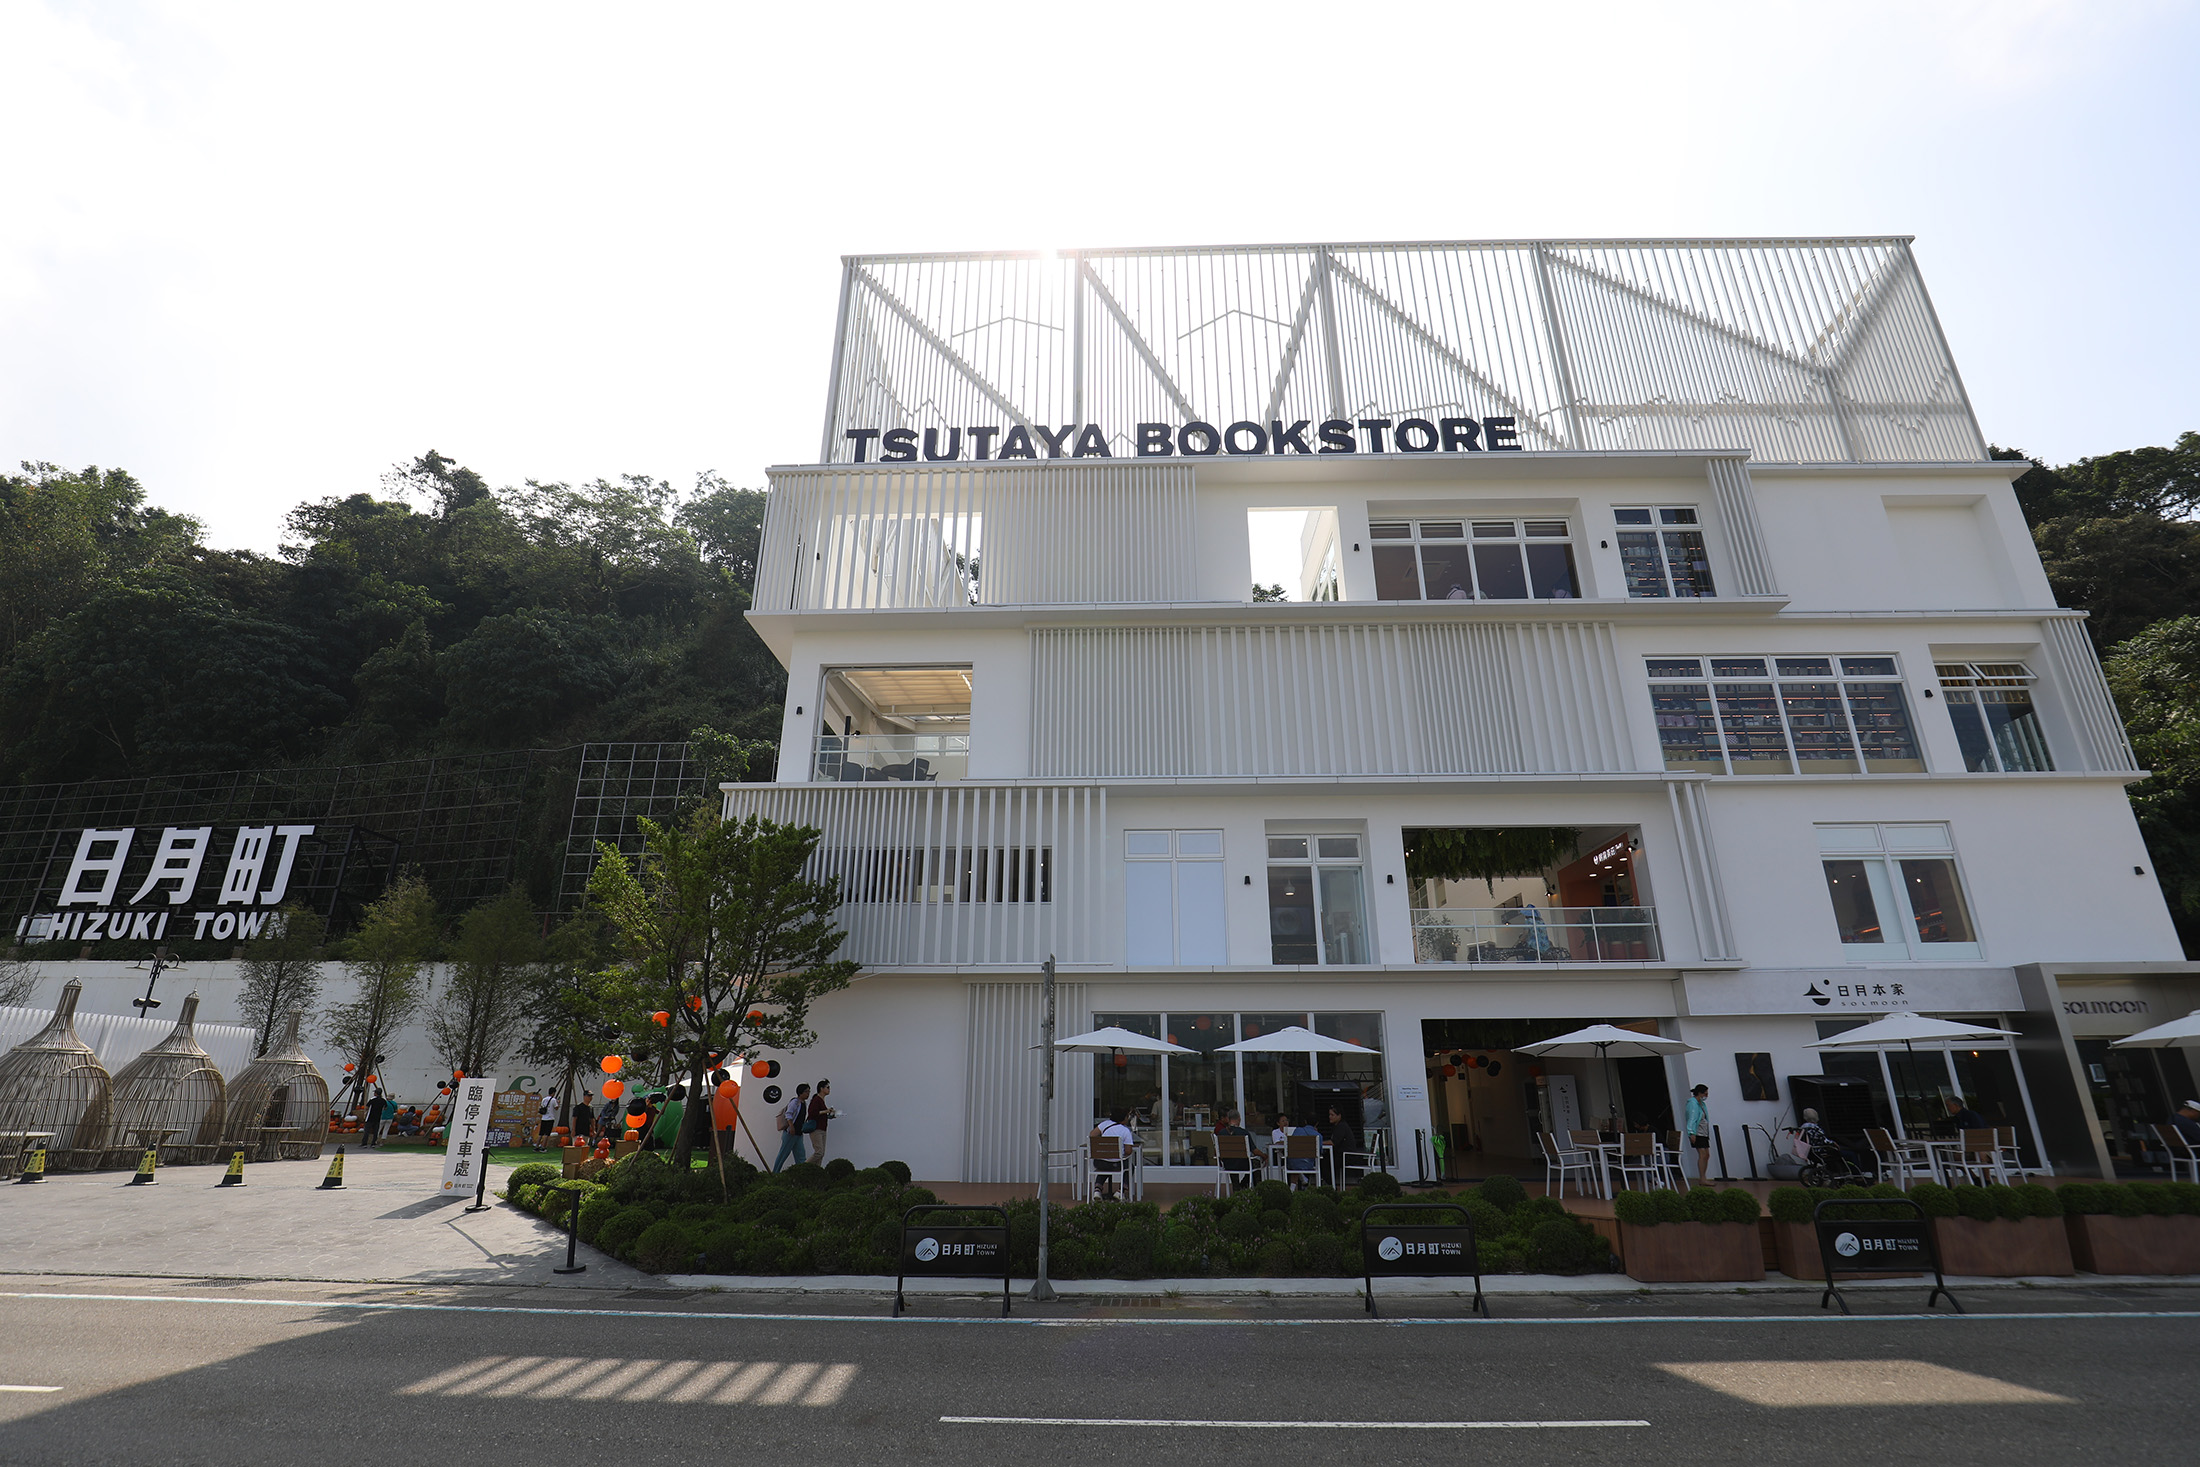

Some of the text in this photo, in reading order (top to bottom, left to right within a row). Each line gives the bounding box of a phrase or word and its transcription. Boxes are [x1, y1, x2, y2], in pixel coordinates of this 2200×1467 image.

[846, 416, 1523, 464] TSUTAYA BOOKSTORE
[57, 824, 316, 906] 日月町
[44, 911, 169, 941] HIZUKI
[1837, 983, 1905, 997] 日月本家
[453, 1085, 484, 1177] 臨停下車處
[942, 1243, 976, 1256] 日月町
[1405, 1242, 1440, 1255] 日月町
[1861, 1238, 1897, 1251] 日月町
